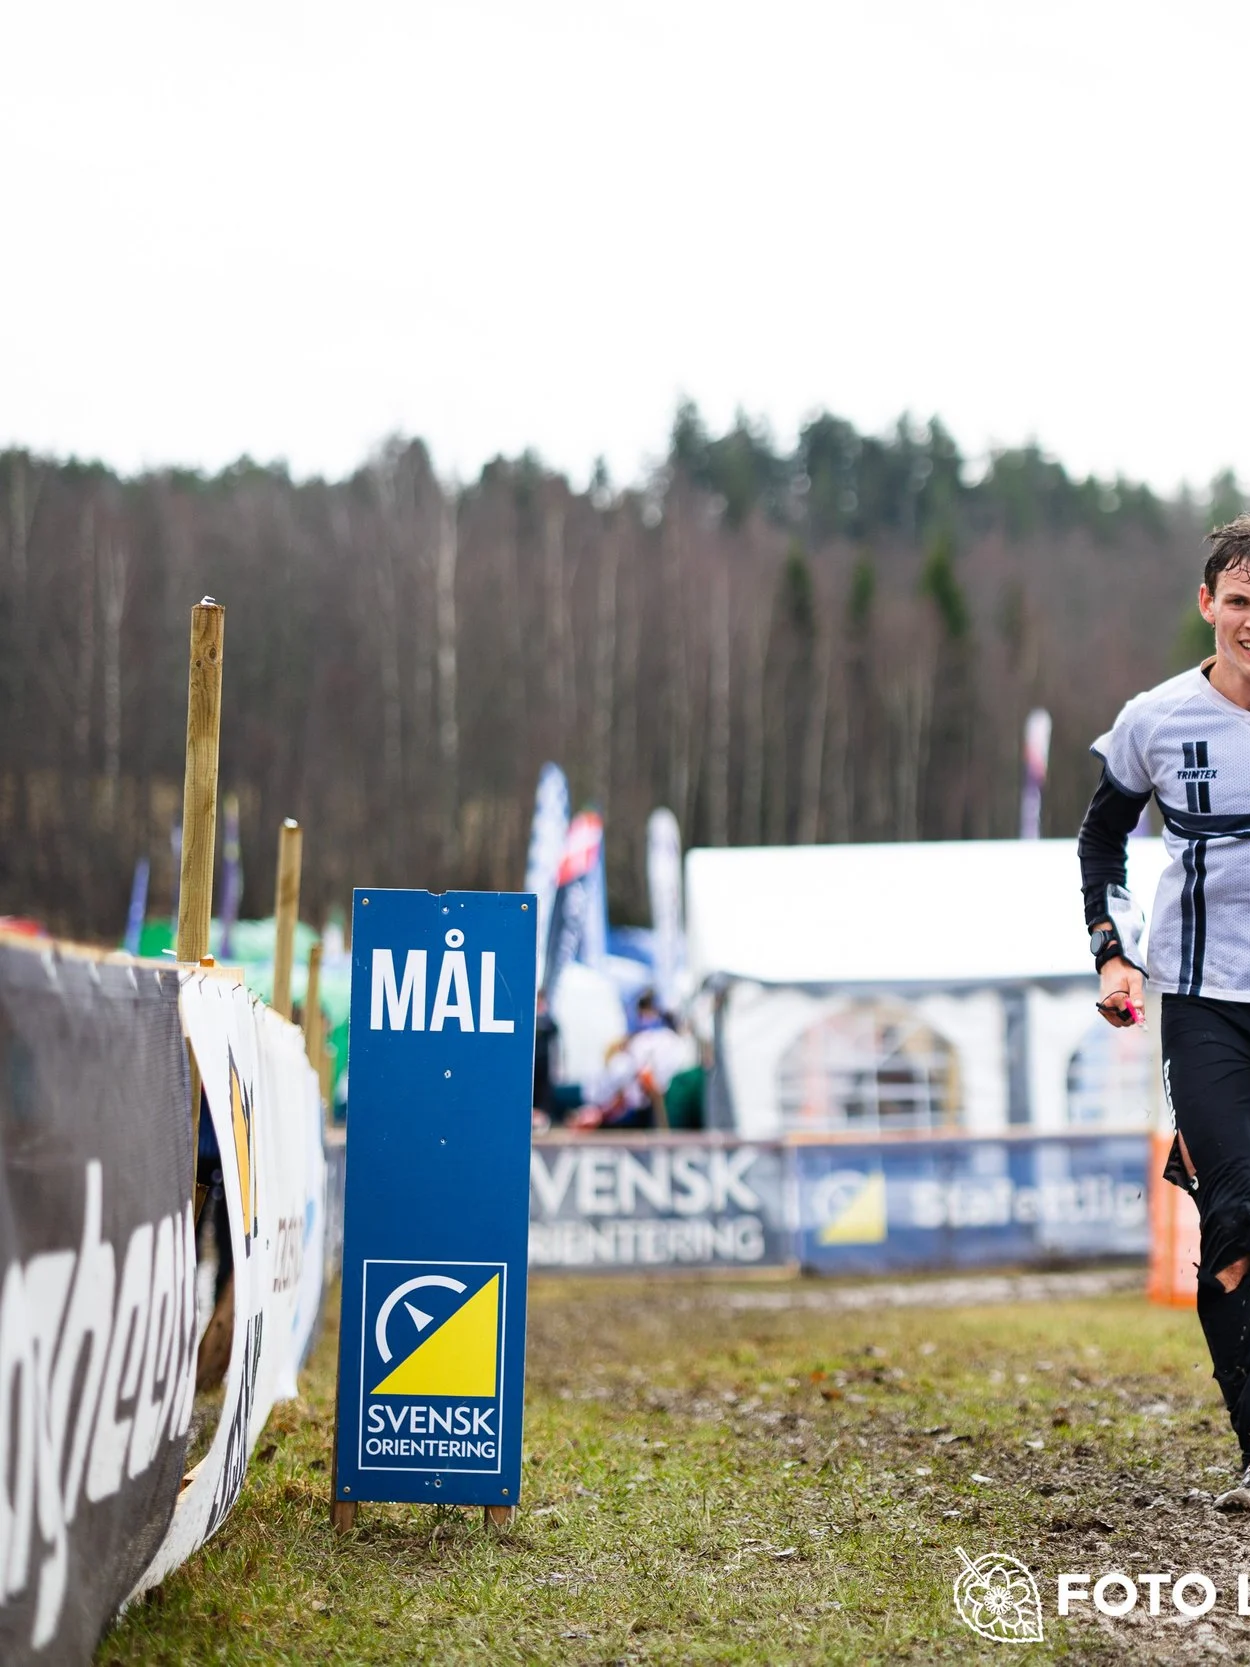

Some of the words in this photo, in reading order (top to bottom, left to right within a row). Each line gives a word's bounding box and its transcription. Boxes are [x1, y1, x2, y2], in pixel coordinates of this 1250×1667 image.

[1177, 769, 1217, 780] TRIMTEX
[369, 928, 515, 1034] MÅL
[529, 1146, 762, 1217] VENSK
[528, 1214, 766, 1266] RIENTERING
[367, 1404, 497, 1436] SVENSK
[365, 1438, 497, 1459] ORIENTERING
